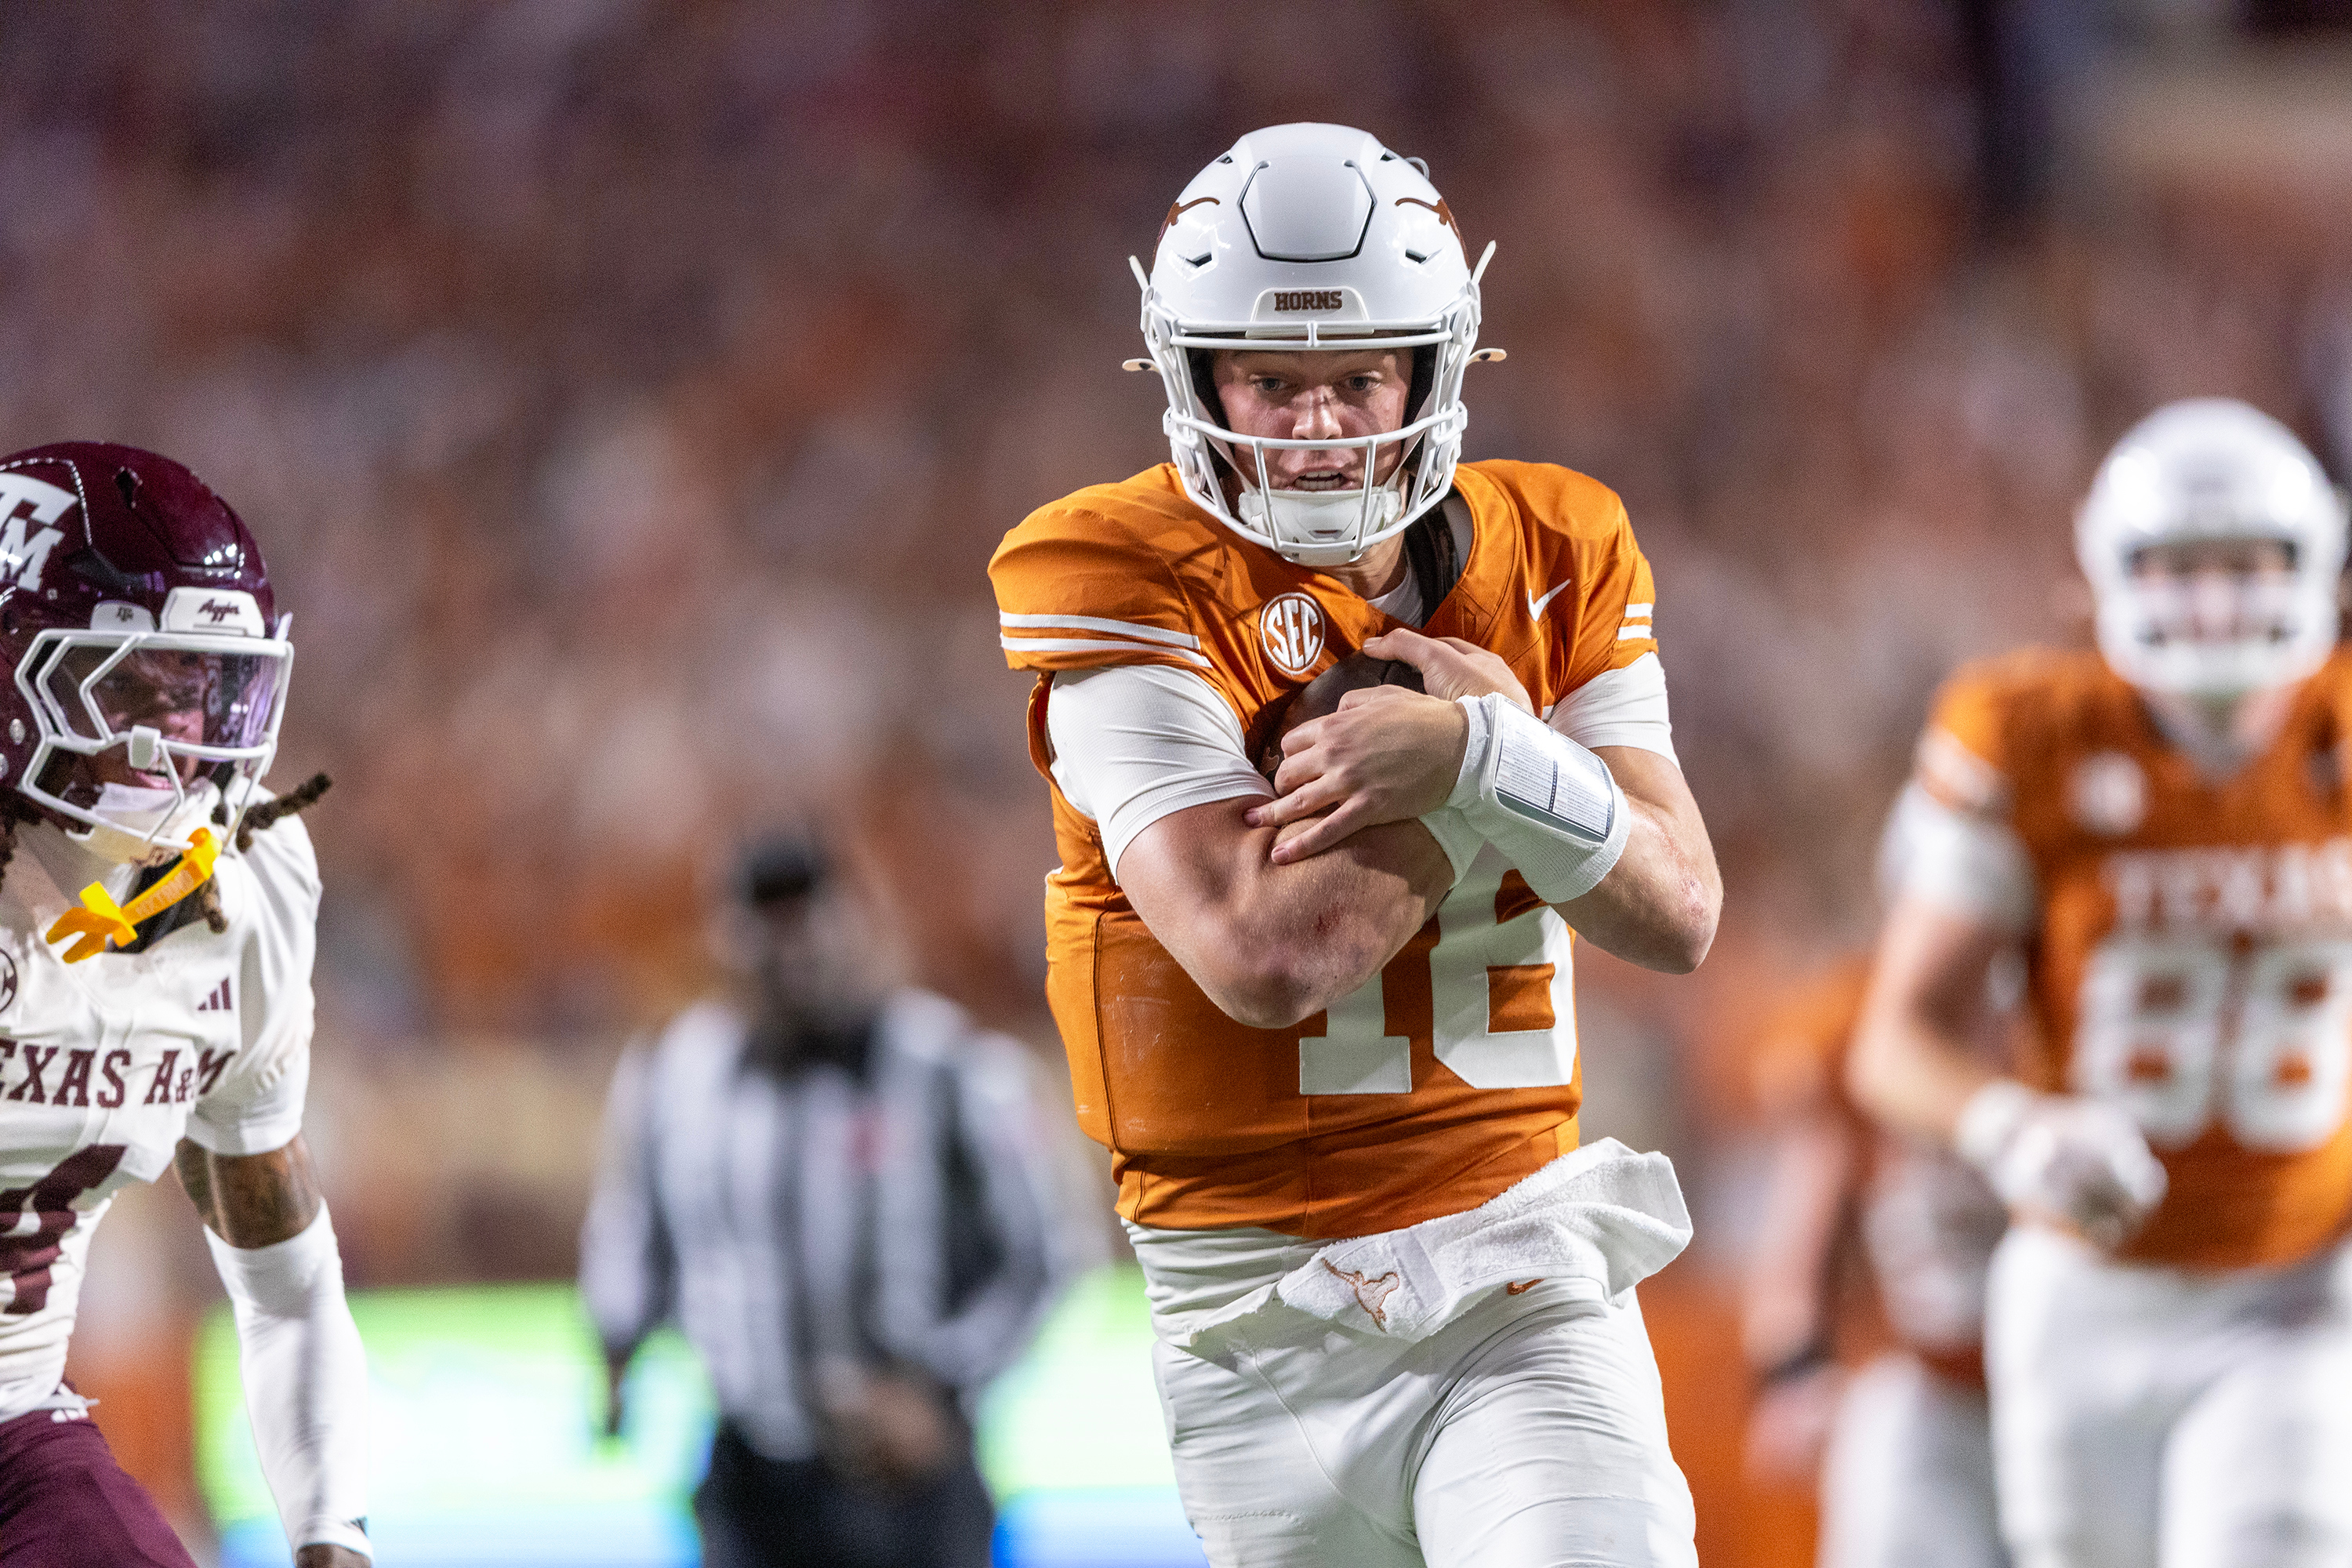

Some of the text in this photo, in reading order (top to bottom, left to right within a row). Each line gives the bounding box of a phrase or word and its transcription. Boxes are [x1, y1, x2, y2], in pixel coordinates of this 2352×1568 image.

[1274, 291, 1343, 311] HORNS
[1266, 598, 1319, 669] SEC
[2074, 939, 2349, 1151] 88
